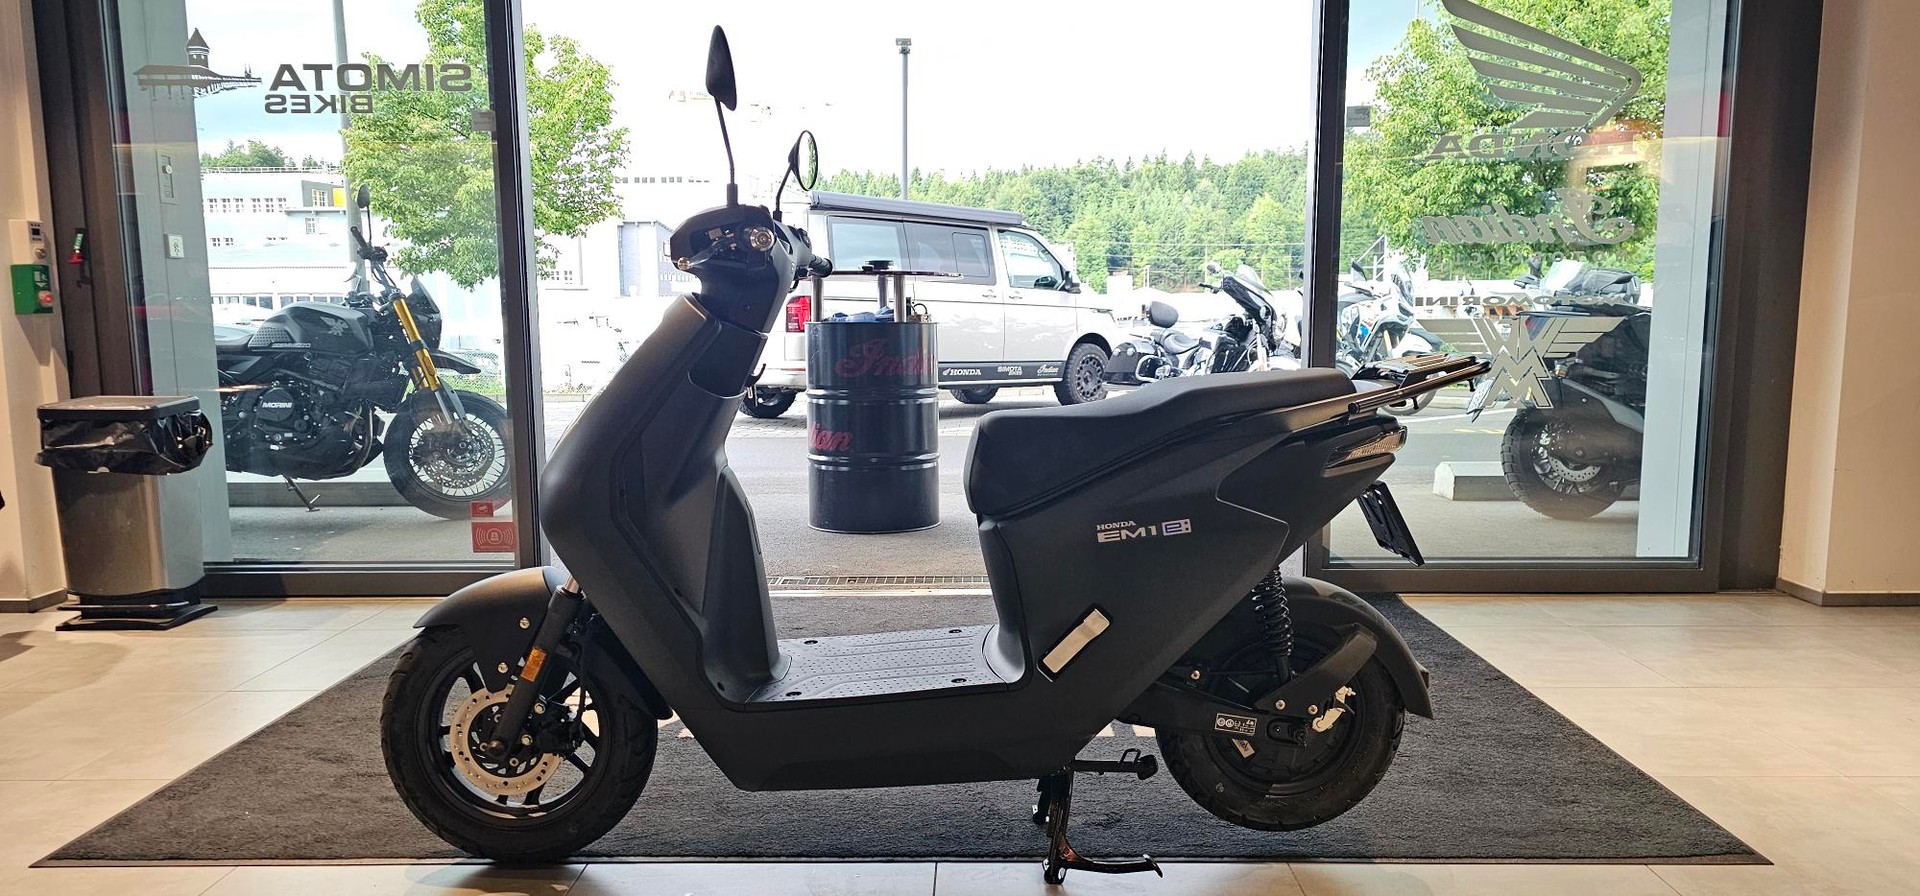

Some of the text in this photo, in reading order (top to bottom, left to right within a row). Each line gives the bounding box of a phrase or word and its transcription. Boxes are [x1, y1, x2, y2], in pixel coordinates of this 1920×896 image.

[949, 368, 982, 376] HONDA
[1096, 520, 1137, 531] HONDA
[1097, 525, 1157, 543] EM1
